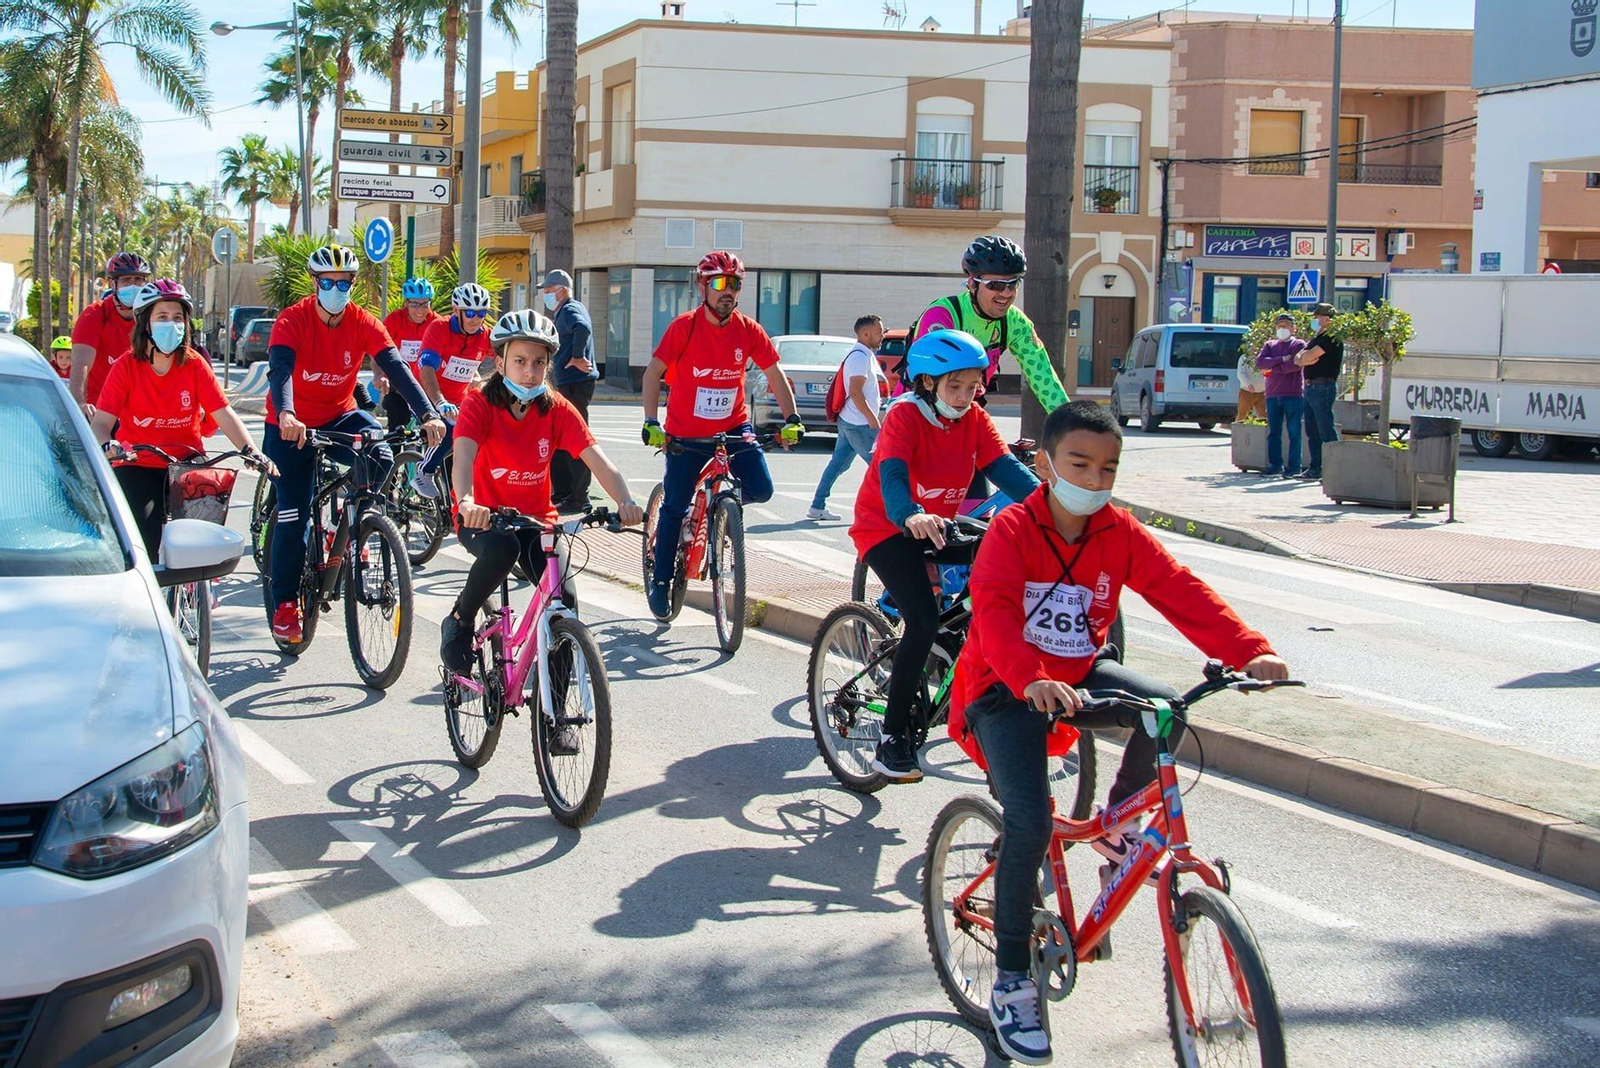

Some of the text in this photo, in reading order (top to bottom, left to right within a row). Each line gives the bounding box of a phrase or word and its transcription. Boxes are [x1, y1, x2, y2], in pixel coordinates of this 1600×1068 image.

[343, 115, 419, 128] mercado de abastos
[343, 147, 411, 158] guardia civil
[343, 178, 393, 187] recinto ferial
[342, 188, 413, 198] parque periurbano
[1207, 228, 1257, 237] CAFETERÍA
[1208, 233, 1290, 254] PAPEPE
[454, 366, 470, 375] 101
[706, 396, 729, 407] 118
[1405, 384, 1490, 415] CHURRERIA
[1526, 391, 1586, 422] MARIA
[508, 470, 520, 480] El
[945, 488, 958, 499] El
[1026, 590, 1040, 599] DIA
[1055, 593, 1064, 604] LA
[1036, 607, 1087, 634] 269
[1033, 633, 1043, 642] 10
[1043, 635, 1054, 645] de
[1054, 638, 1075, 648] abril
[1076, 639, 1087, 648] de
[1092, 840, 1144, 924] SPEED
